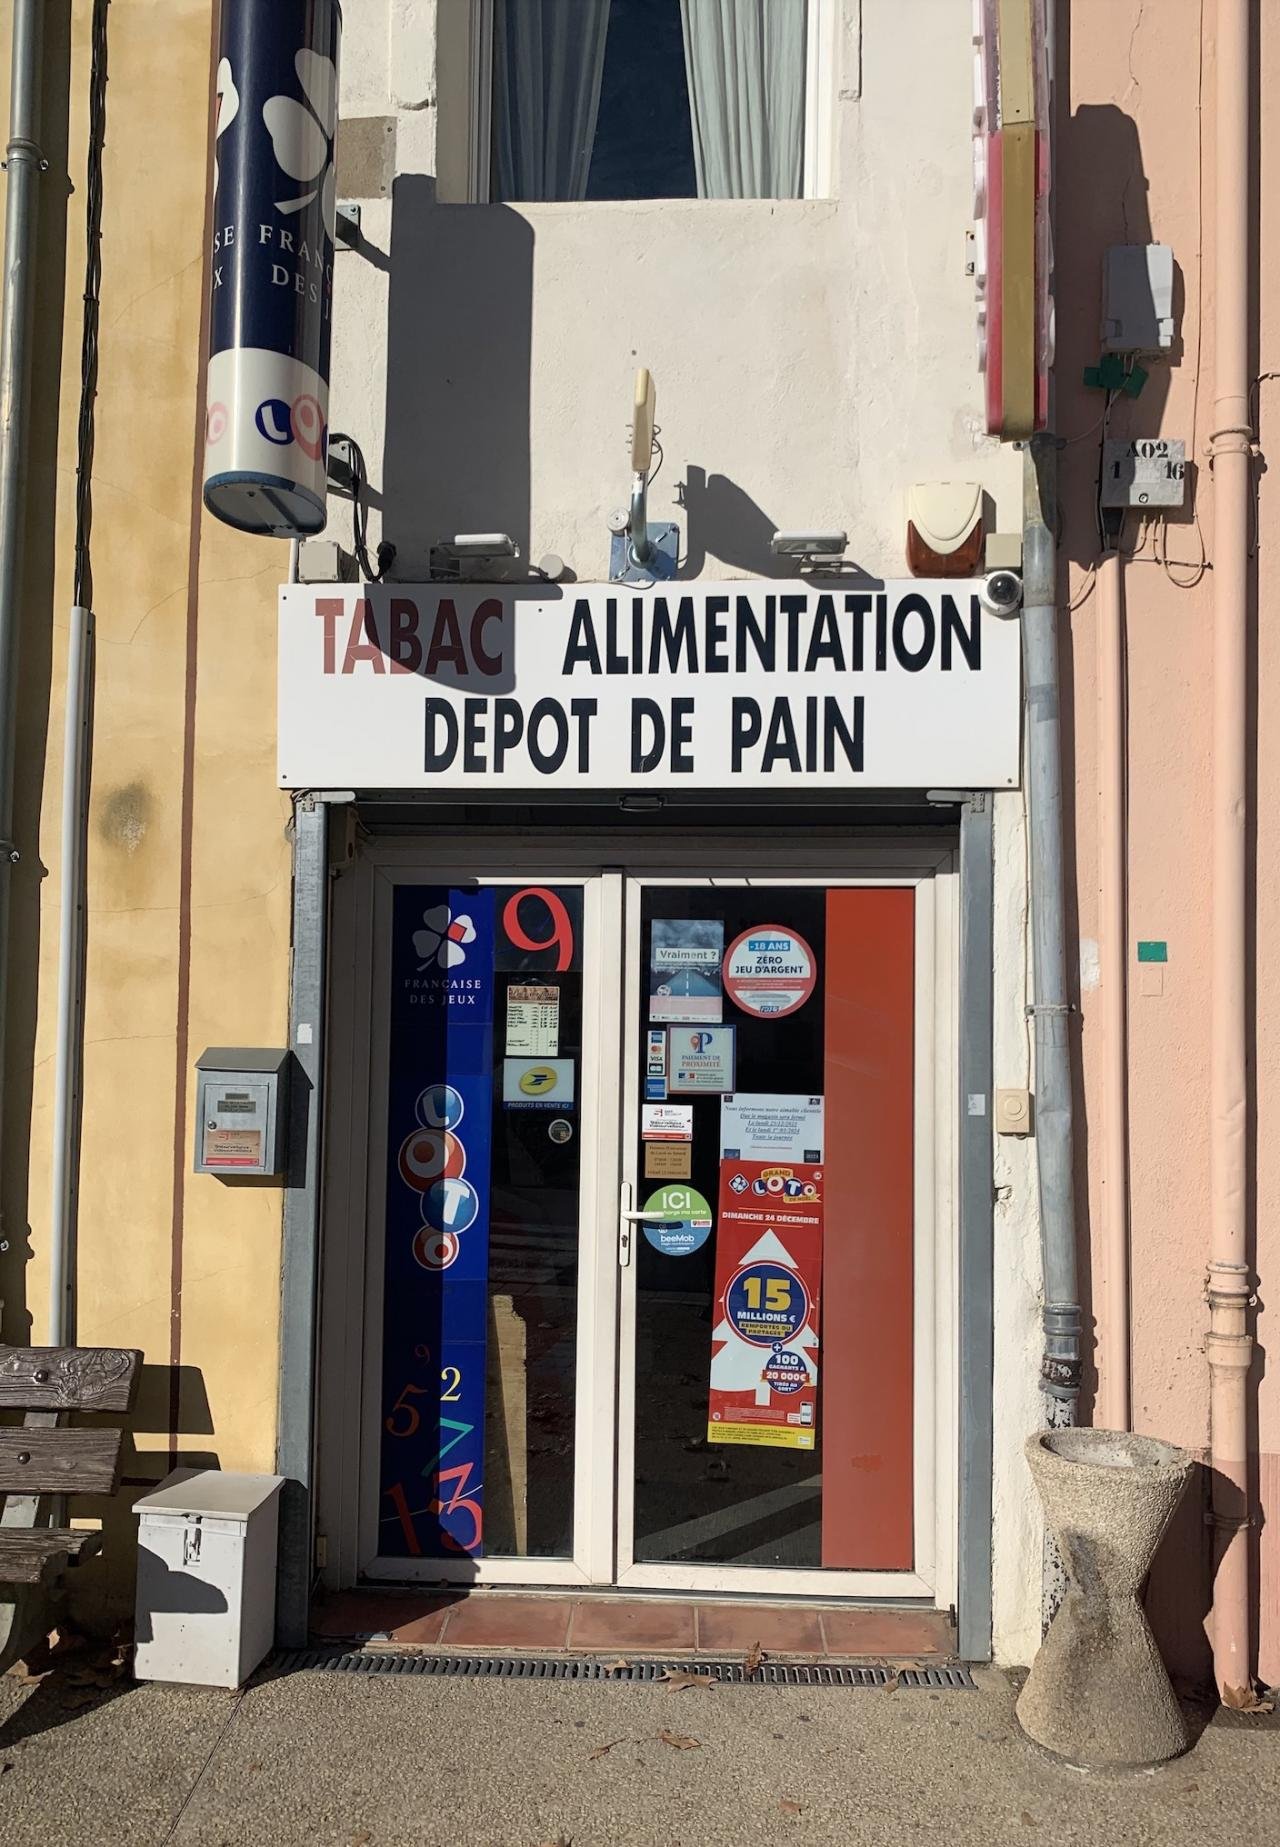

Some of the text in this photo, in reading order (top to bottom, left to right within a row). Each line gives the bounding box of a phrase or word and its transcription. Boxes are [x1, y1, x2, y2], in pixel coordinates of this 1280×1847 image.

[271, 264, 318, 303] DES
[1165, 461, 1185, 480] 16
[315, 593, 982, 675] TABAC ALIMENTATION
[424, 695, 865, 774] DEPOT DE PAIN
[503, 888, 574, 971] 9
[750, 941, 789, 950] -18 ANS
[660, 950, 708, 959] Vraiment
[755, 965, 804, 974] D'ARGENT
[404, 979, 481, 992] FRANÇAISE
[410, 995, 475, 1006] DES JEUX
[663, 1192, 690, 1209] ICI
[722, 1212, 763, 1221] DIMANCHE
[743, 1277, 791, 1311] 15
[737, 1311, 796, 1323] MILLIONS €
[776, 1355, 798, 1365] 100
[441, 1367, 461, 1401] 2
[386, 1384, 429, 1437] 5
